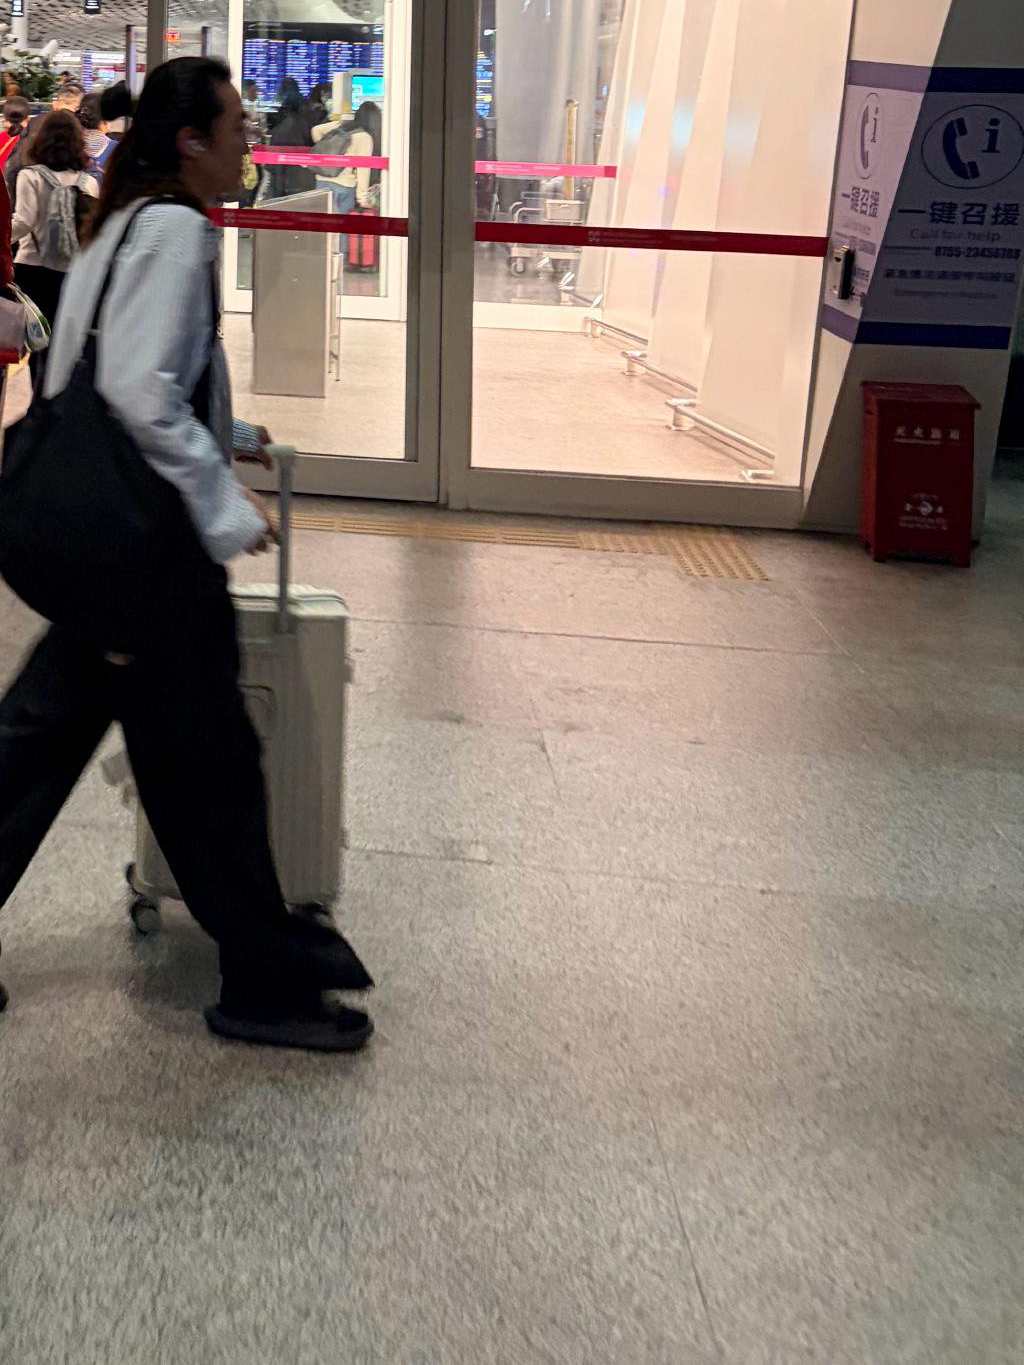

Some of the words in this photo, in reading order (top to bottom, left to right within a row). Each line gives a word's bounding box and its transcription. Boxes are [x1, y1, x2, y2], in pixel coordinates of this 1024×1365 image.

[898, 201, 1021, 226] 一键召援
[967, 230, 1001, 243] help
